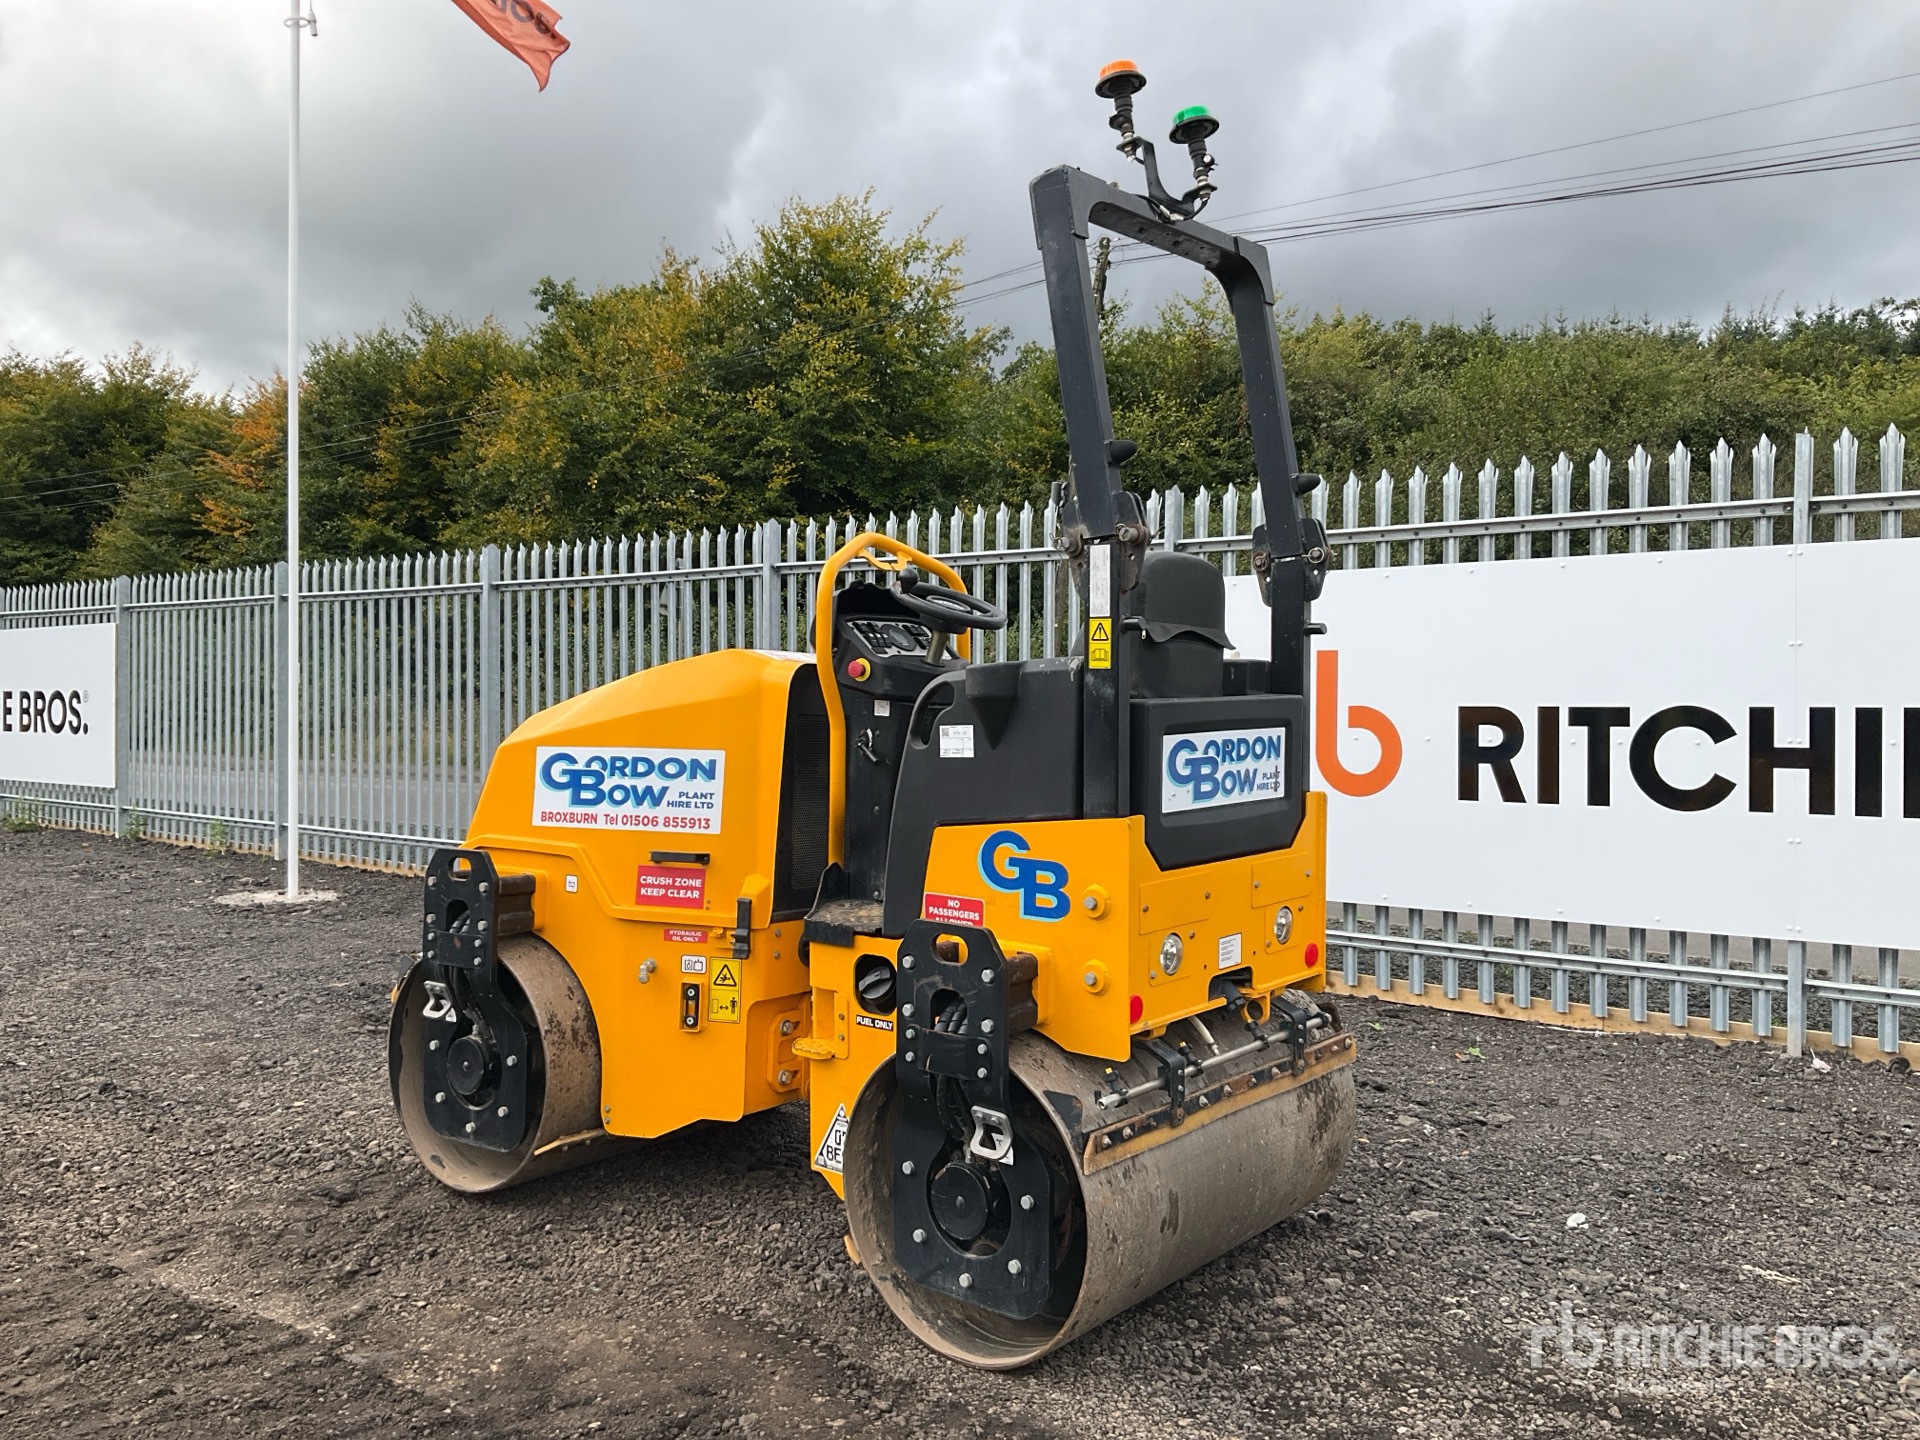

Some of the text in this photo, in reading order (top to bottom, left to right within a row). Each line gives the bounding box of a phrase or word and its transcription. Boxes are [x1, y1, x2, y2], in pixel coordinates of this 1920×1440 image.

[1167, 735, 1281, 788] GORDON
[540, 753, 717, 791] GORDON
[1192, 756, 1258, 804] BOW
[1257, 782, 1269, 791] HIRE
[568, 769, 669, 809] BOW
[678, 791, 715, 801] PLANT
[666, 800, 714, 810] HIRE LTD
[540, 811, 711, 830] BROXBURN Tel 01506 855913
[640, 876, 703, 888] CRUSH ZONE
[977, 830, 1071, 922] GB
[640, 887, 700, 899] KEEP CLEAR
[947, 899, 960, 909] NO
[928, 906, 980, 921] PASSENGERS
[856, 1015, 894, 1030] FUEL ONLY
